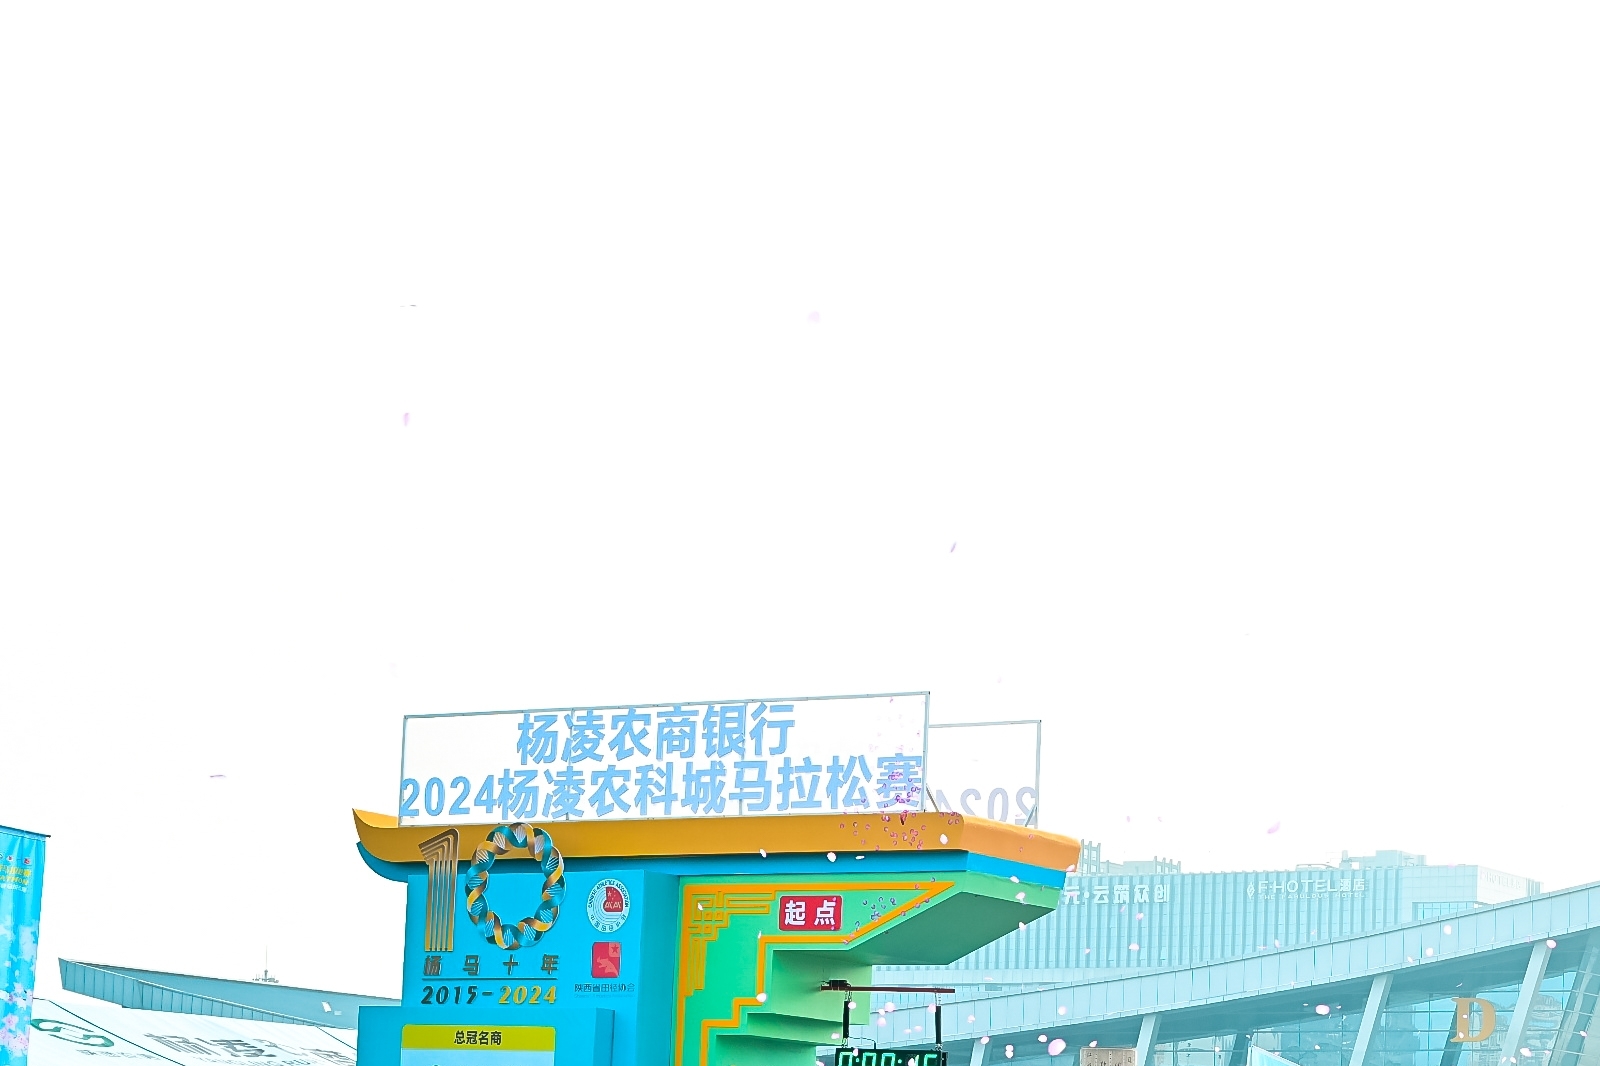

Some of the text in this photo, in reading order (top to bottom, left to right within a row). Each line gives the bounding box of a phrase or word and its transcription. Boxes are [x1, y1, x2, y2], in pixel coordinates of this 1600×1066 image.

[516, 703, 796, 766] 杨凌农商银行
[400, 753, 923, 820] 2024杨凌农科城马拉松赛
[783, 899, 838, 929] 起点
[420, 985, 558, 1005] 2015-2024
[454, 1030, 503, 1046] 总冠名商
[1450, 997, 1496, 1043] D
